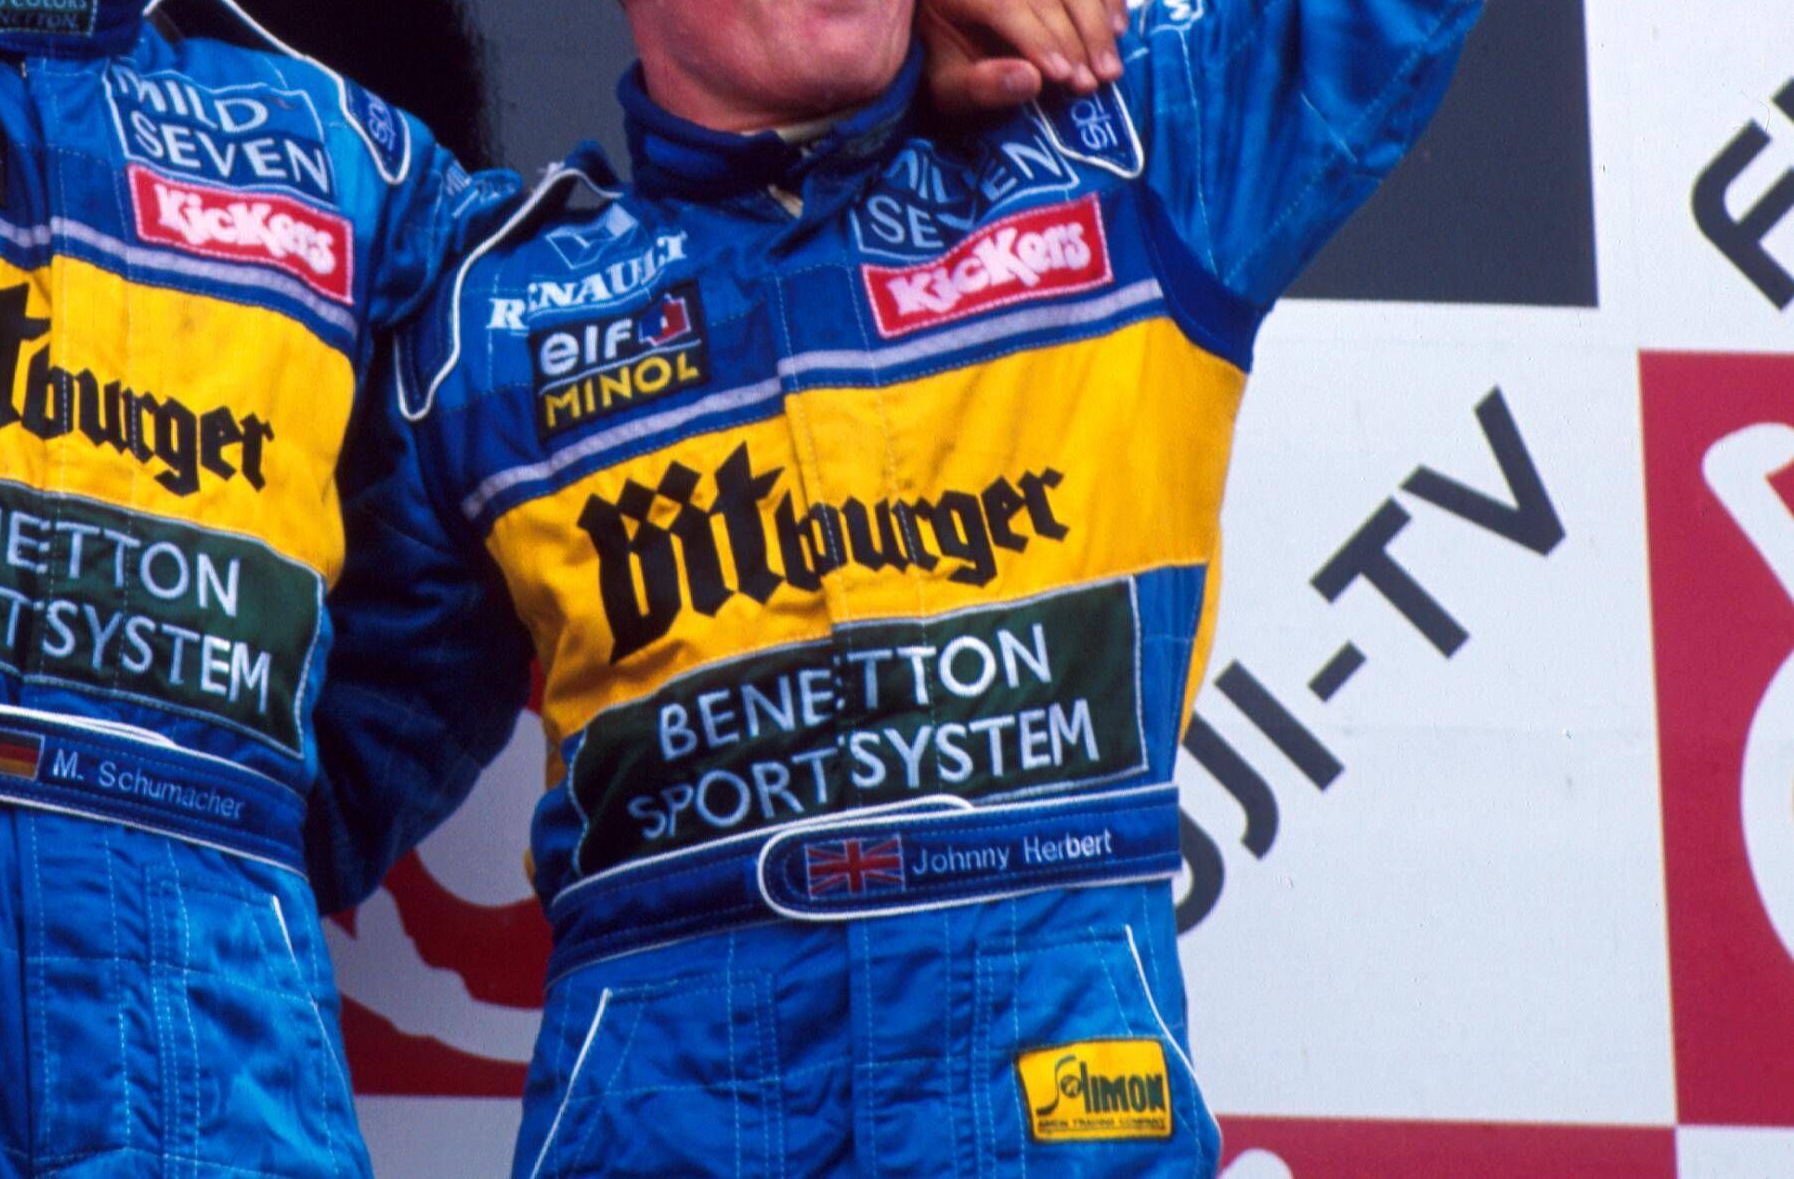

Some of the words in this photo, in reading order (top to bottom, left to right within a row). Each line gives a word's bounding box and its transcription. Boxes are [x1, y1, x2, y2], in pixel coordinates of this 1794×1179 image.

[112, 70, 268, 134] MILD
[129, 108, 333, 192] SEVEN
[539, 317, 634, 377] elf
[544, 351, 700, 428] MINOL
[575, 439, 1070, 665] Bitburger
[658, 621, 1052, 764] BENETTON
[51, 748, 85, 782] M.
[97, 761, 246, 821] Schumacher
[911, 834, 1012, 878] Johnny
[1022, 828, 1114, 862] Herbert
